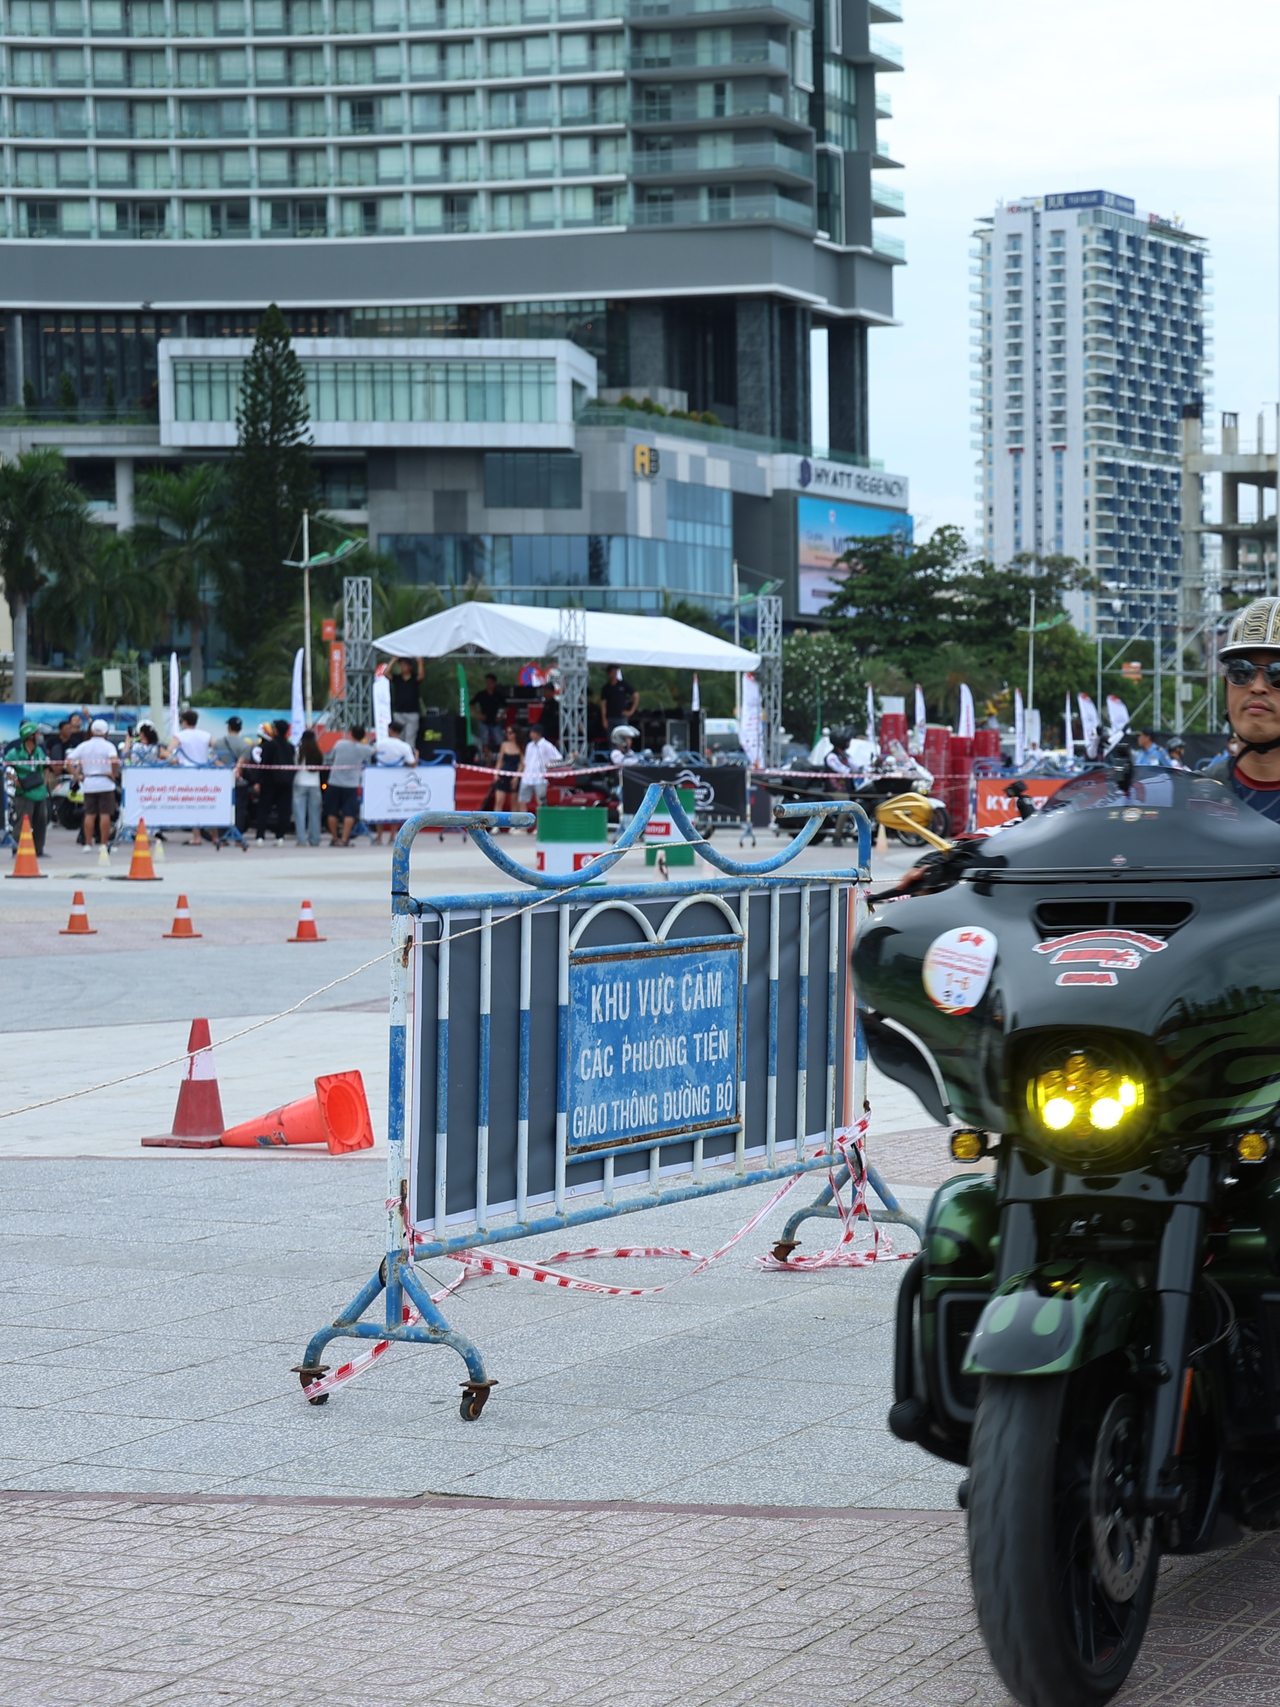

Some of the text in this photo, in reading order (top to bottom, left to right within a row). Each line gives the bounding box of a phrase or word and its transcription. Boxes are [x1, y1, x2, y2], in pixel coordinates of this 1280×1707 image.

[814, 468, 905, 497] HYATT REGENCY
[591, 981, 631, 1023] KHU
[638, 972, 675, 1023] VỰC
[580, 1024, 729, 1081] CÁC PHƯƠNG TIỆN
[573, 1074, 733, 1138] GIAO THÔNG ĐƯỜNG BỘ
